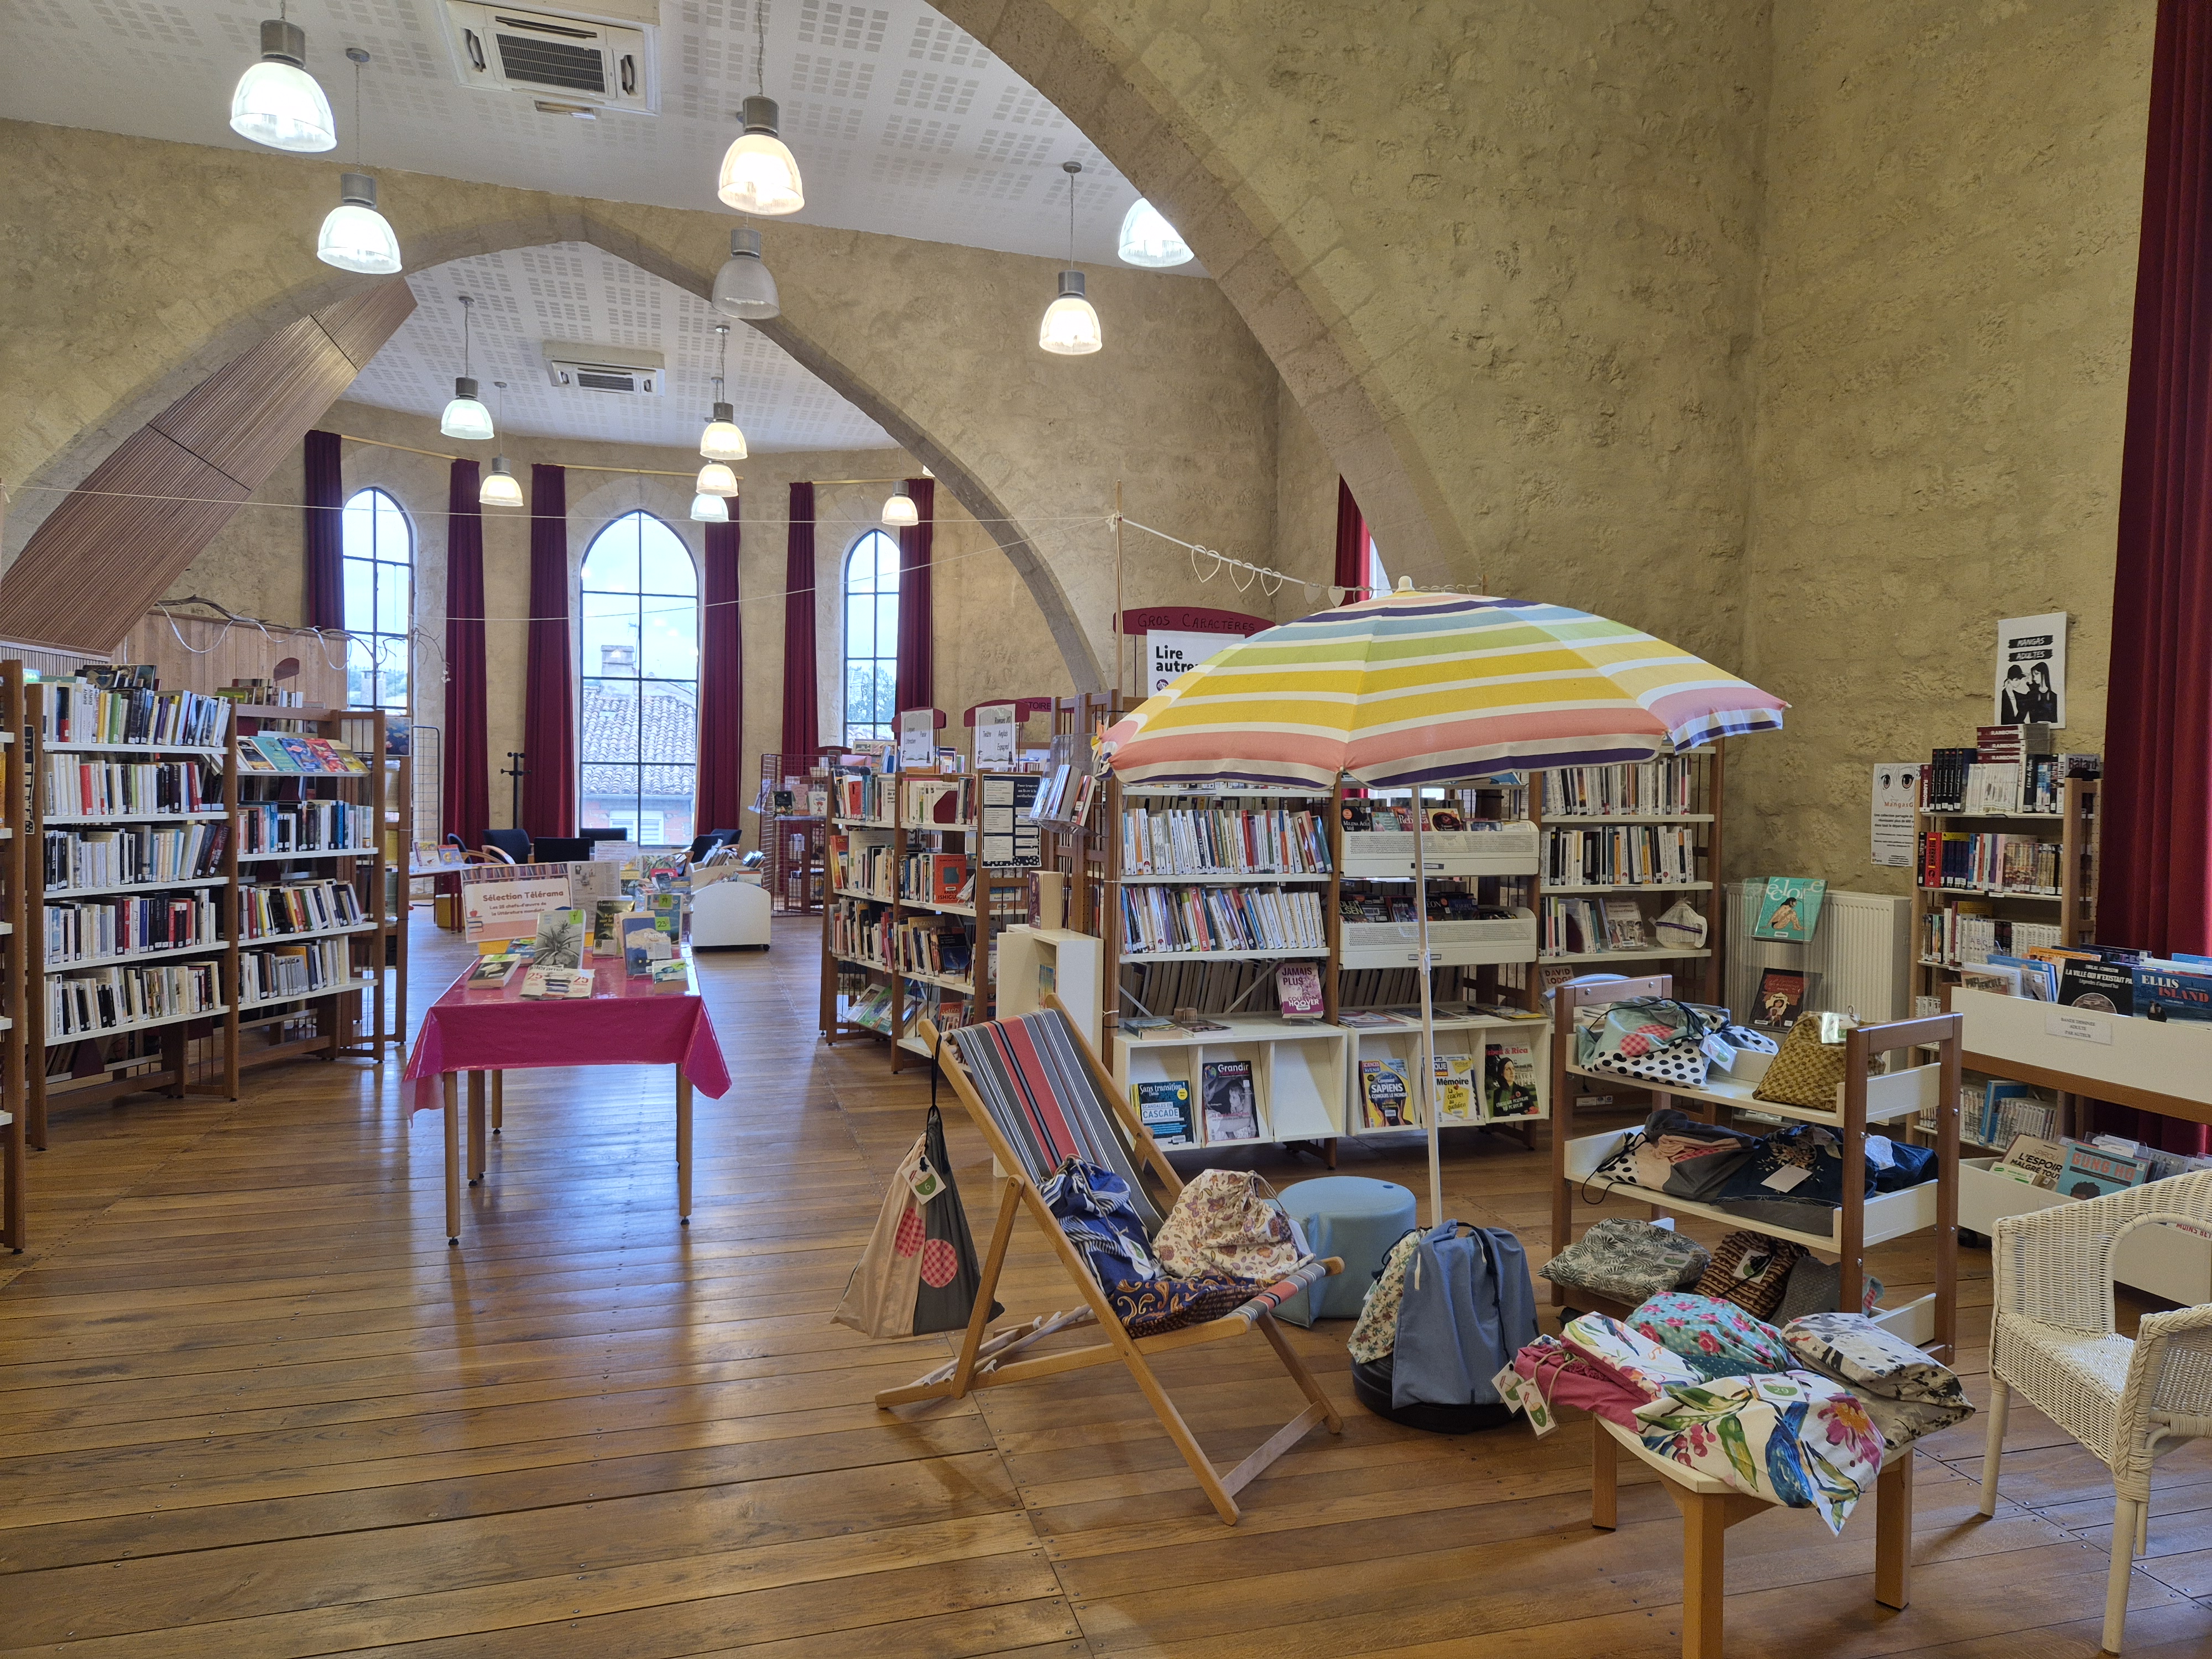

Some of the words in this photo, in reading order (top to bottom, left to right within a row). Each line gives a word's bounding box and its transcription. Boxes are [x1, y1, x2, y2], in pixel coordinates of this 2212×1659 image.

[1138, 613, 1170, 627] GROS
[2017, 637, 2046, 647] MANGAS
[1156, 645, 1183, 660] Lire
[2015, 651, 2046, 660] ADULTES
[1156, 660, 1200, 672] autre
[1029, 701, 1051, 709] TOIRE
[1399, 813, 1429, 824] Rebca
[483, 893, 522, 902] Sélection
[524, 890, 564, 899] Télérama
[1282, 967, 1313, 976] JAMAIS
[1545, 968, 1570, 977] DAVID
[2073, 969, 2087, 978] VILLE
[2097, 973, 2125, 983] N'EXISTAIT
[1283, 977, 1304, 985] PLUS
[2141, 974, 2179, 989] ELLIS
[2158, 987, 2210, 1003] ISLAND
[1218, 1062, 1249, 1072] Grandir
[1436, 1077, 1469, 1086] Mémoire
[1139, 1084, 1154, 1097] Sans
[1154, 1083, 1182, 1092] transition
[1371, 1083, 1404, 1093] SAPIENS
[1142, 1108, 1179, 1119] CASCADE
[2032, 1149, 2059, 1161] SPIROU
[2018, 1152, 2063, 1173] L'ESPOIR
[2071, 1152, 2111, 1174] GUNG
[2114, 1165, 2136, 1181] HO
[2010, 1159, 2042, 1174] MALGRÉ
[2042, 1169, 2061, 1180] TOUT
[925, 1182, 931, 1191] 6
